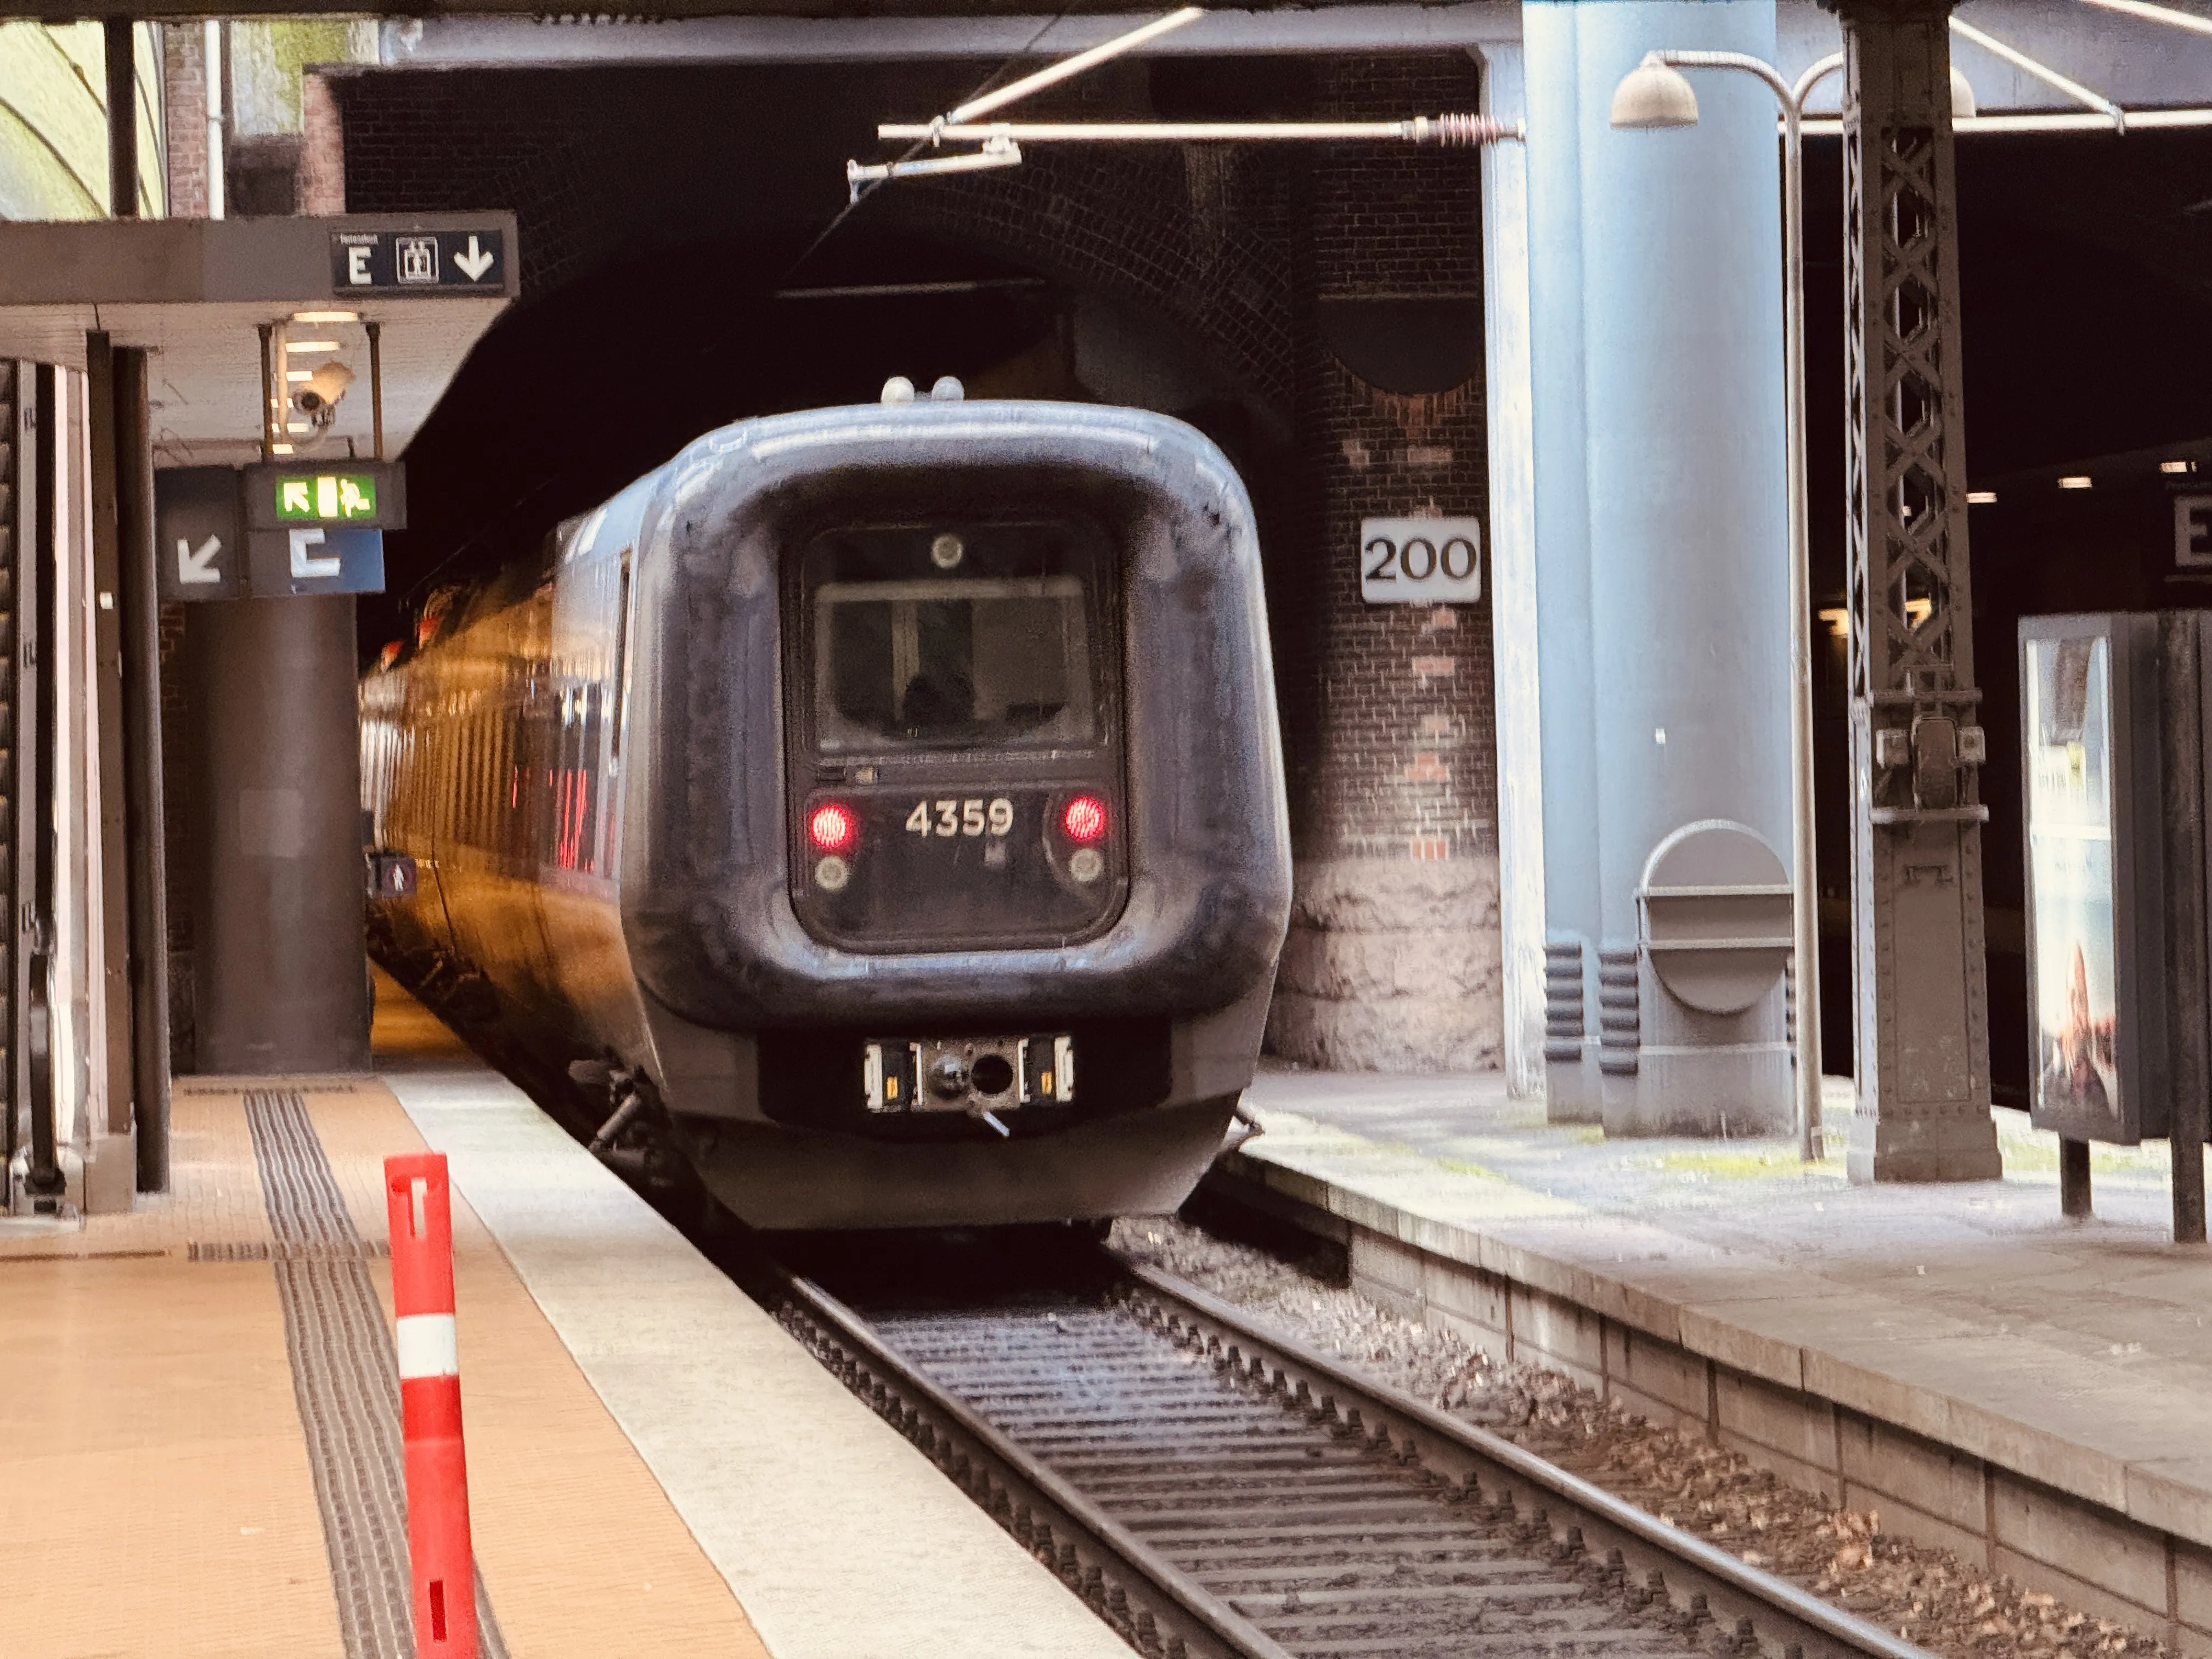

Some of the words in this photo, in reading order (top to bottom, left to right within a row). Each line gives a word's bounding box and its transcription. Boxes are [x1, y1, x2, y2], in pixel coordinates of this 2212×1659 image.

[349, 246, 372, 285] E
[2174, 496, 2212, 567] E
[1364, 537, 1477, 581] 200
[905, 798, 1014, 837] 4359
